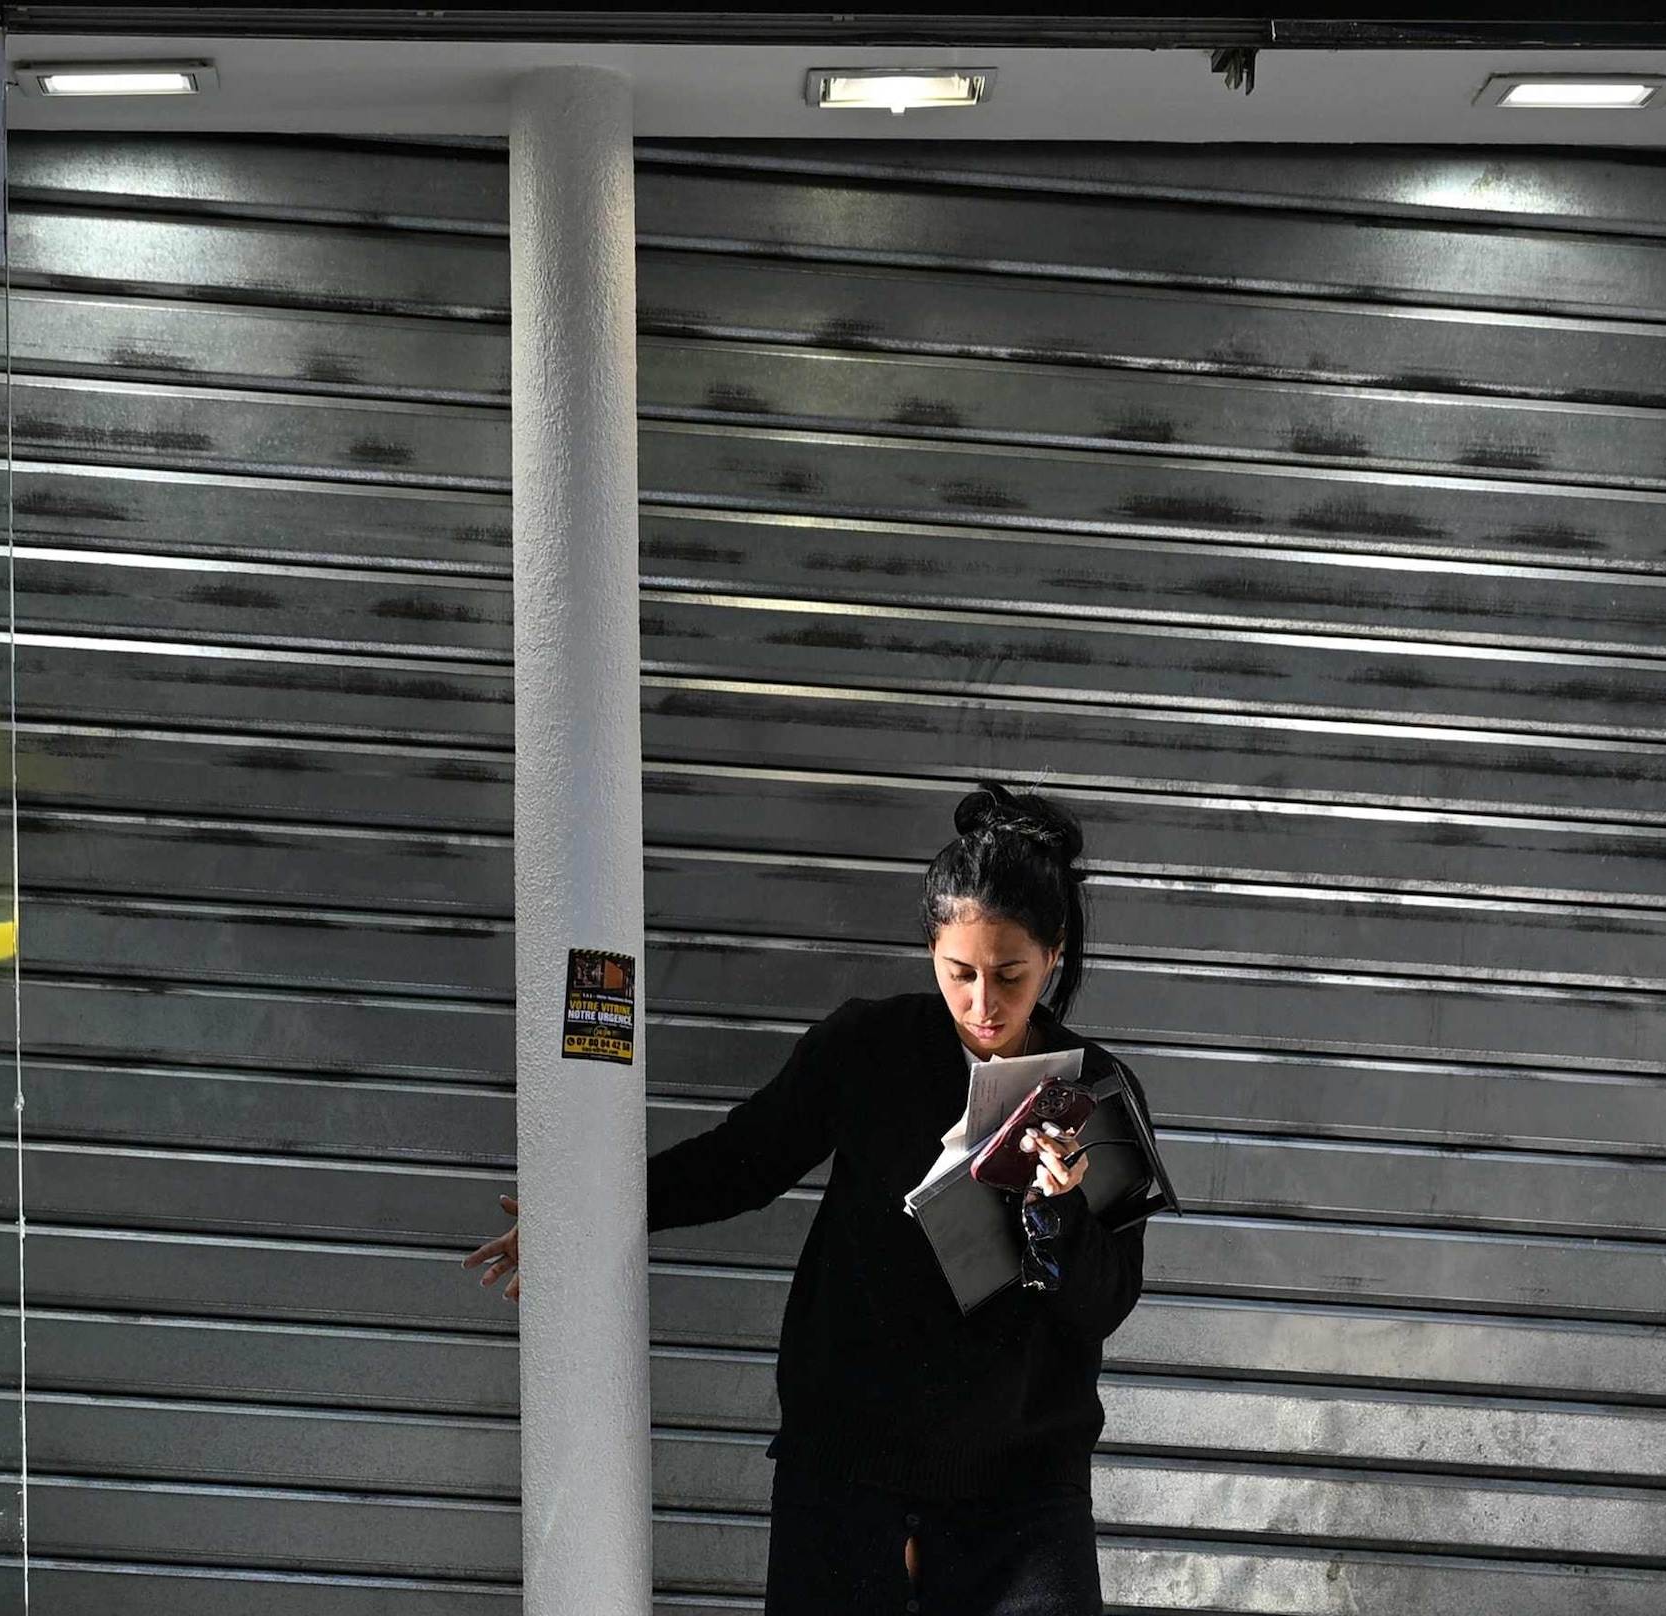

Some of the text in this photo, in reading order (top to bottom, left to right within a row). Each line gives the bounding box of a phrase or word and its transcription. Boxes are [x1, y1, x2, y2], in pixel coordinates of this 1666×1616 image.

[569, 1000, 599, 1011] VOTRE
[568, 1009, 596, 1020] NOTRE
[576, 1038, 586, 1046] 07
